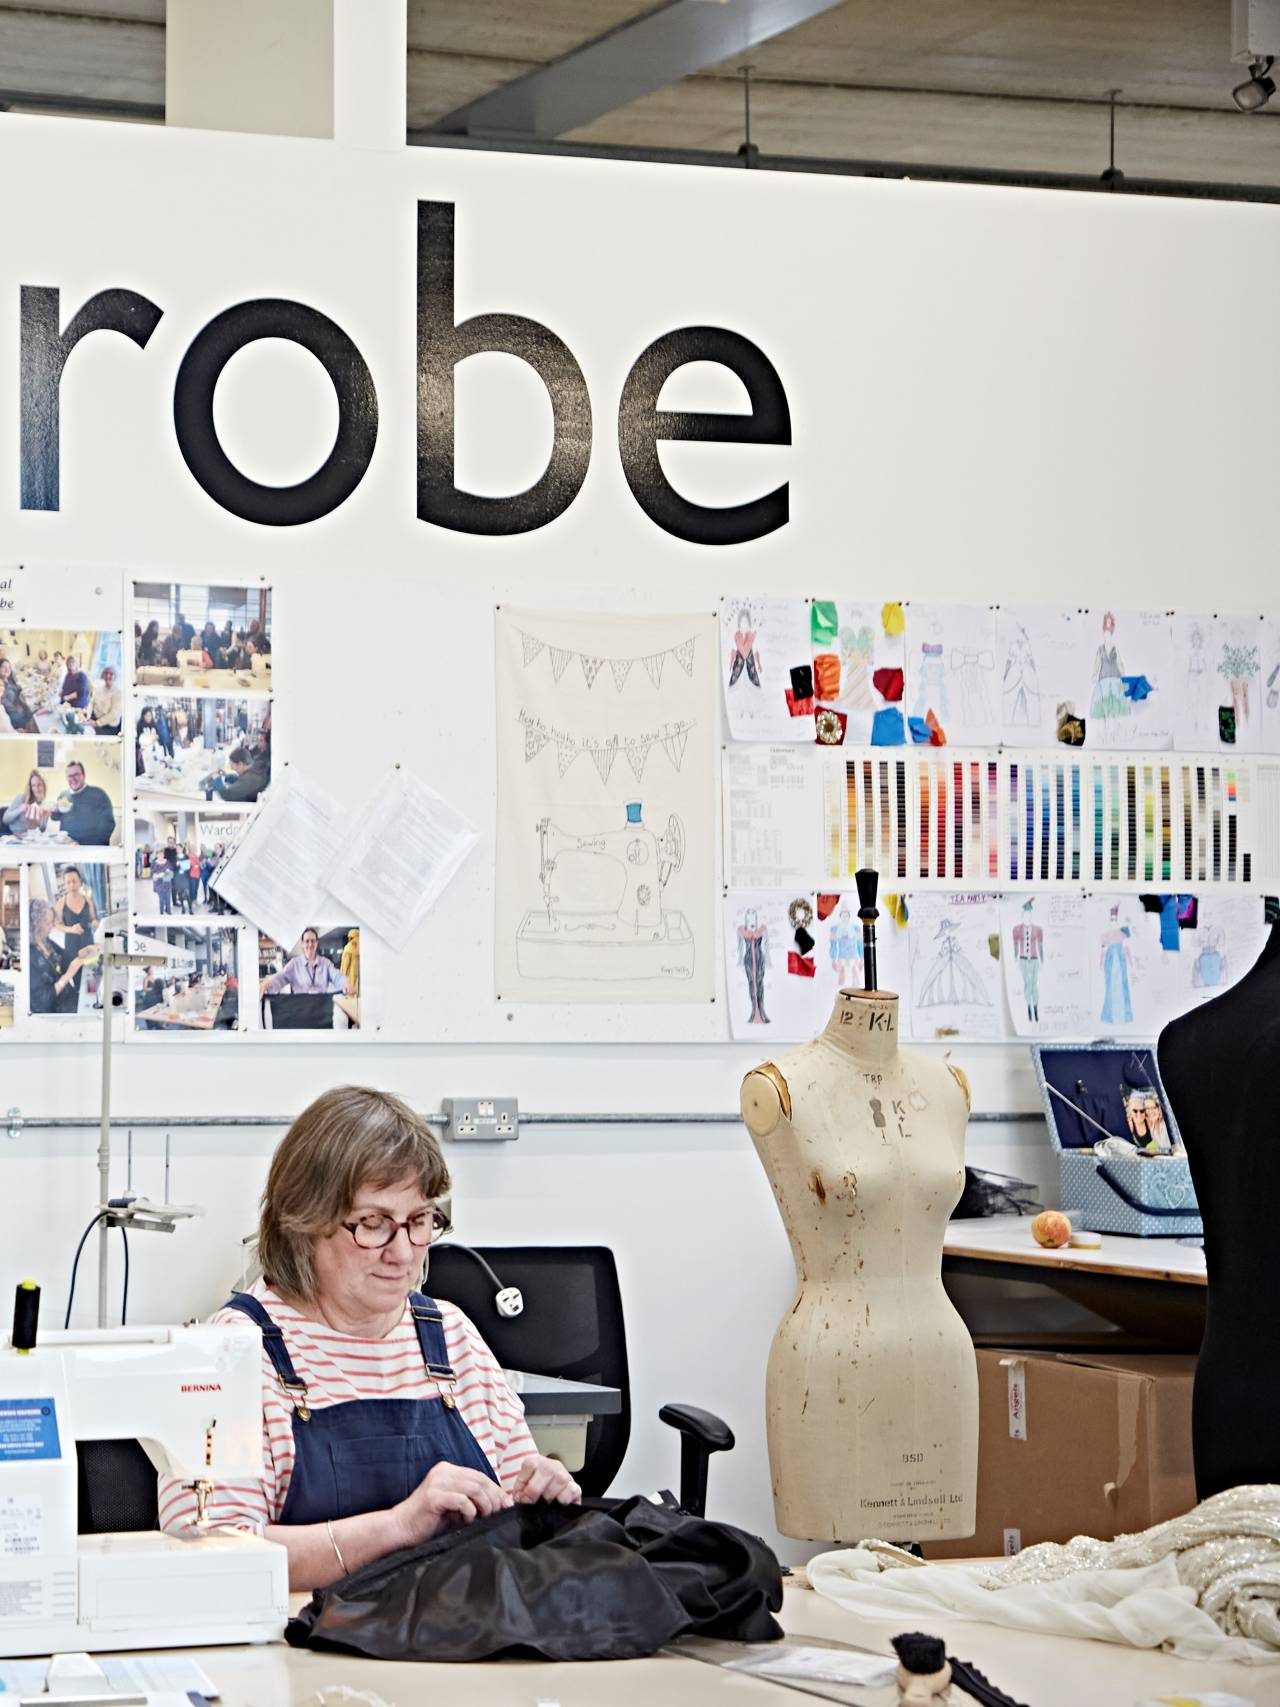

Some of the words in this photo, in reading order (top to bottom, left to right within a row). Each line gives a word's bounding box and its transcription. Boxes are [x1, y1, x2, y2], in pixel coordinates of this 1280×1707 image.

[200, 823, 242, 836] Wardr
[840, 1011, 854, 1025] 12
[862, 1073, 883, 1085] TRP
[892, 1100, 906, 1114] K
[180, 1384, 222, 1393] BERNINA
[1012, 1384, 1021, 1419] Angels
[860, 1498, 898, 1509] Kennett
